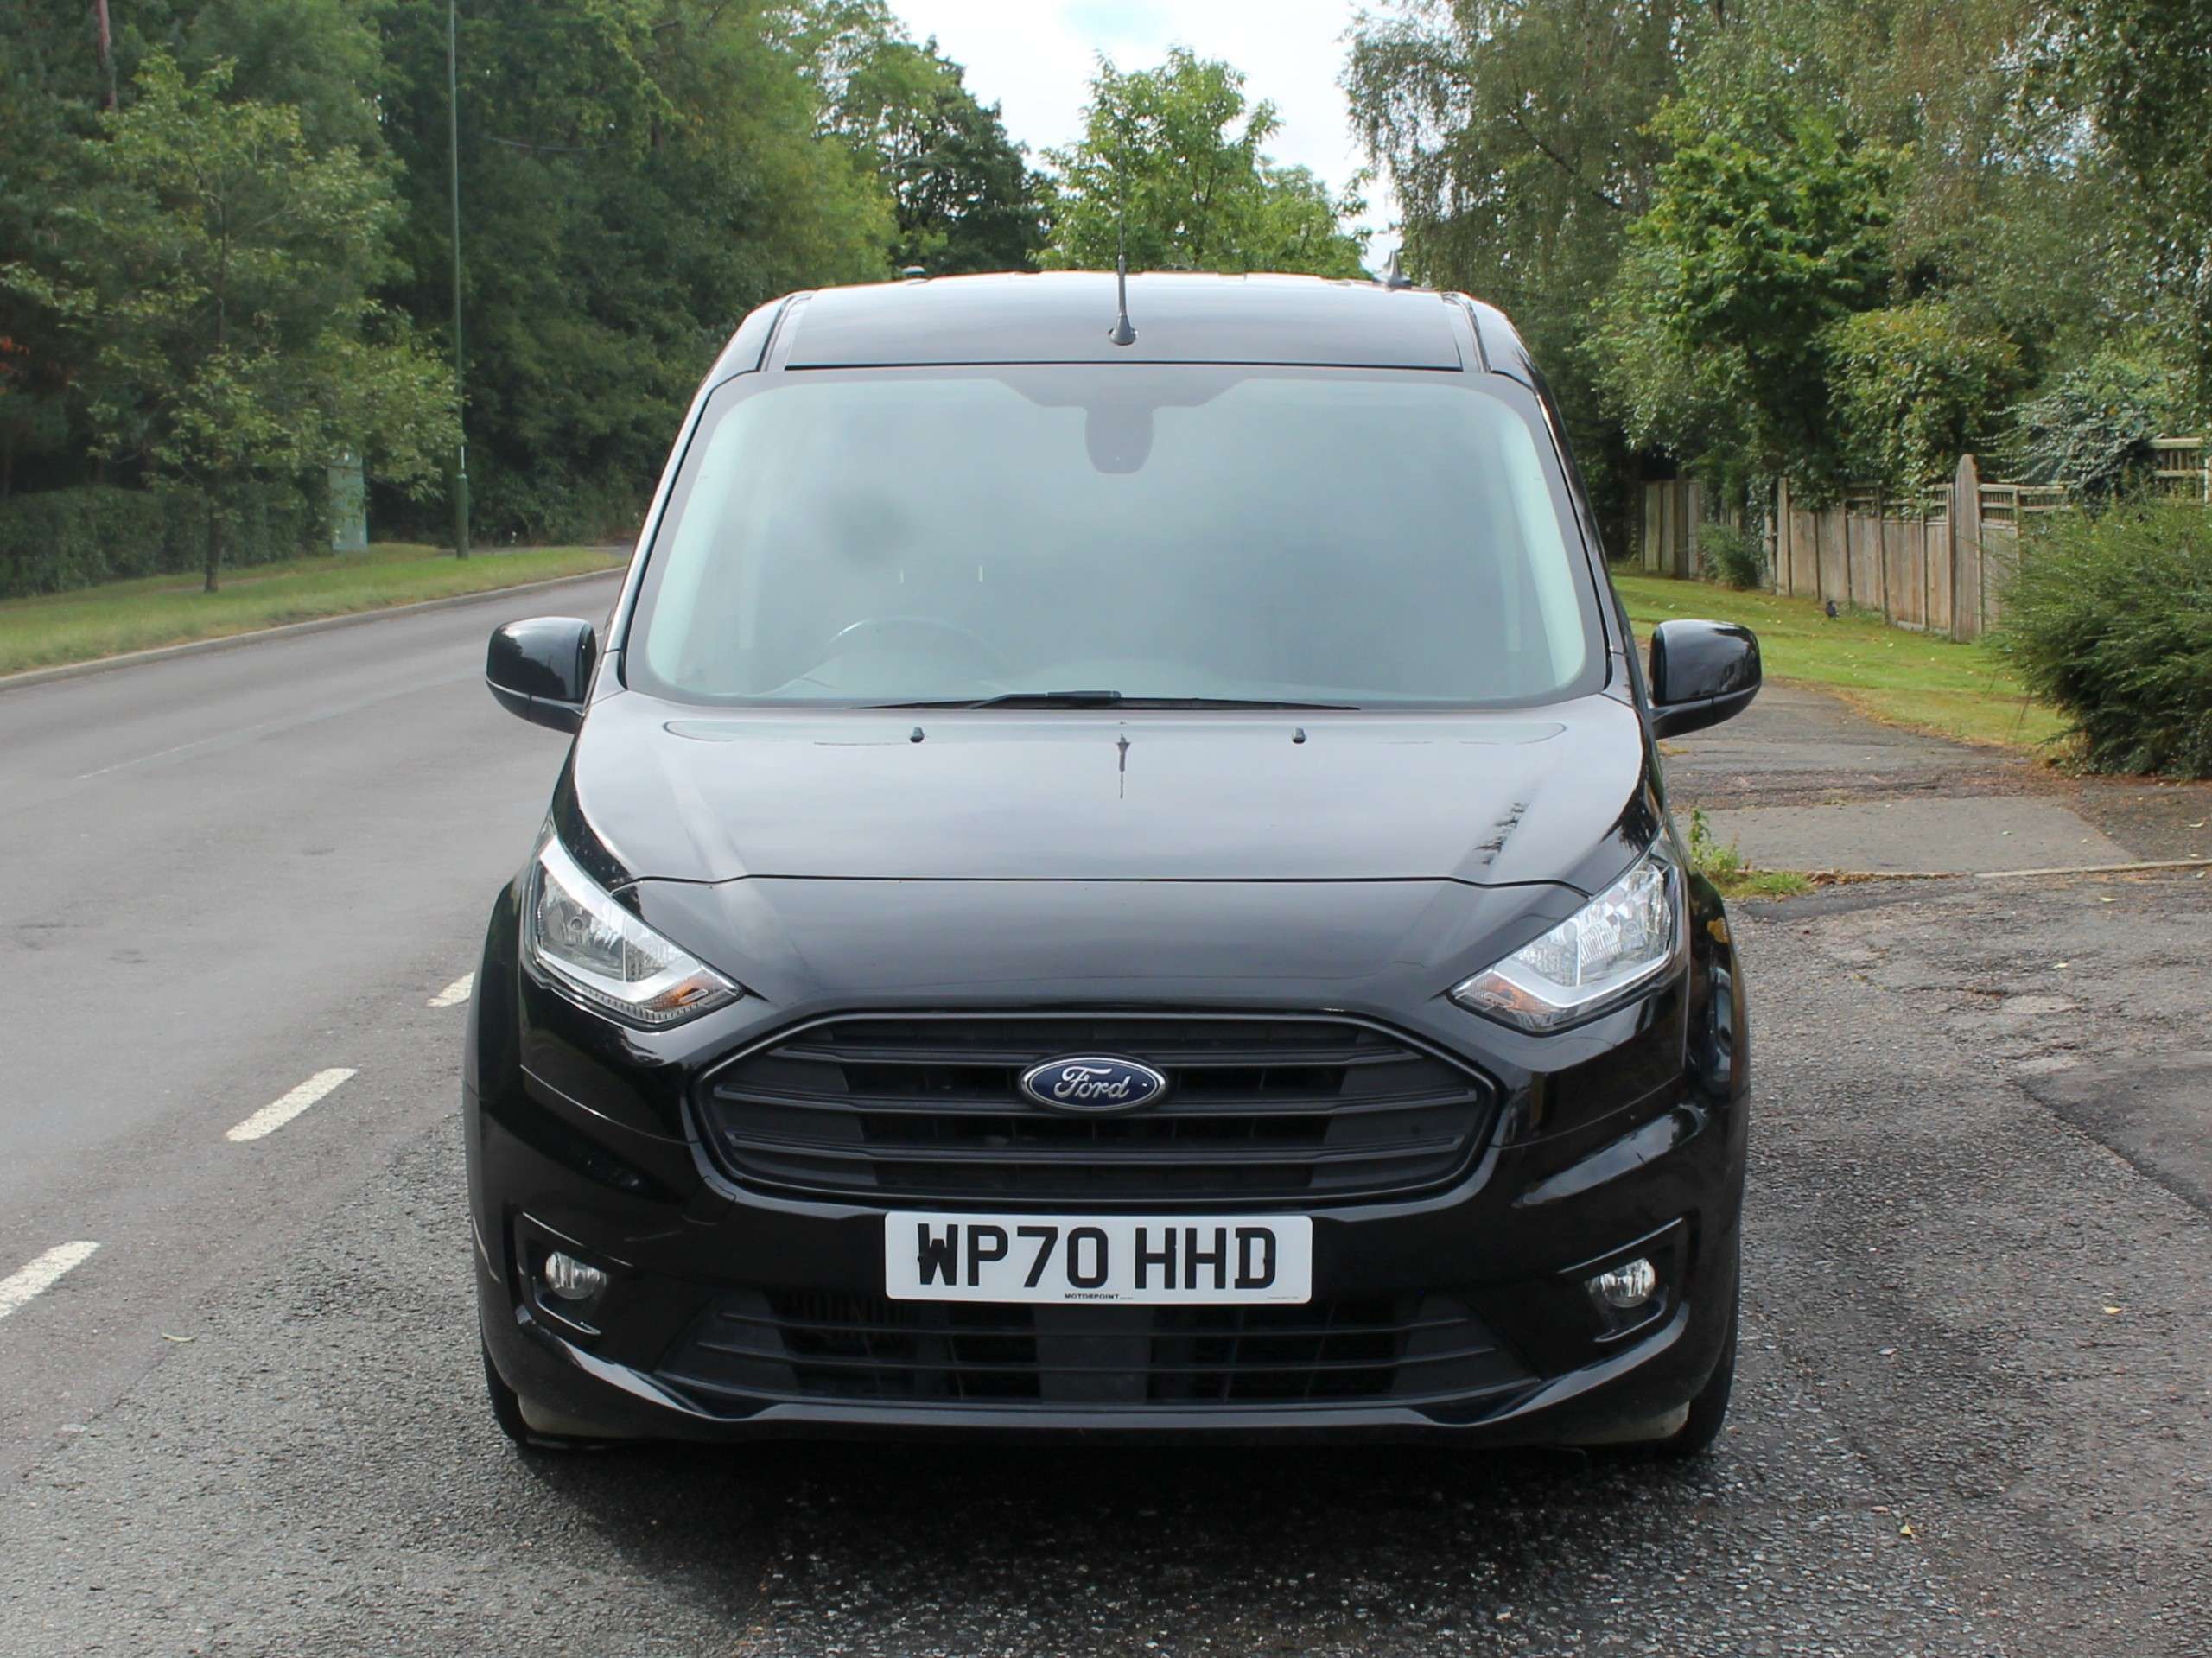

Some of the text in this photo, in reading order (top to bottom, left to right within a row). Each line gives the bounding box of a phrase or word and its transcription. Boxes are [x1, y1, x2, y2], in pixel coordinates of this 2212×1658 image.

[1053, 1065, 1132, 1098] Ford
[917, 1223, 1276, 1289] WP70 HHD
